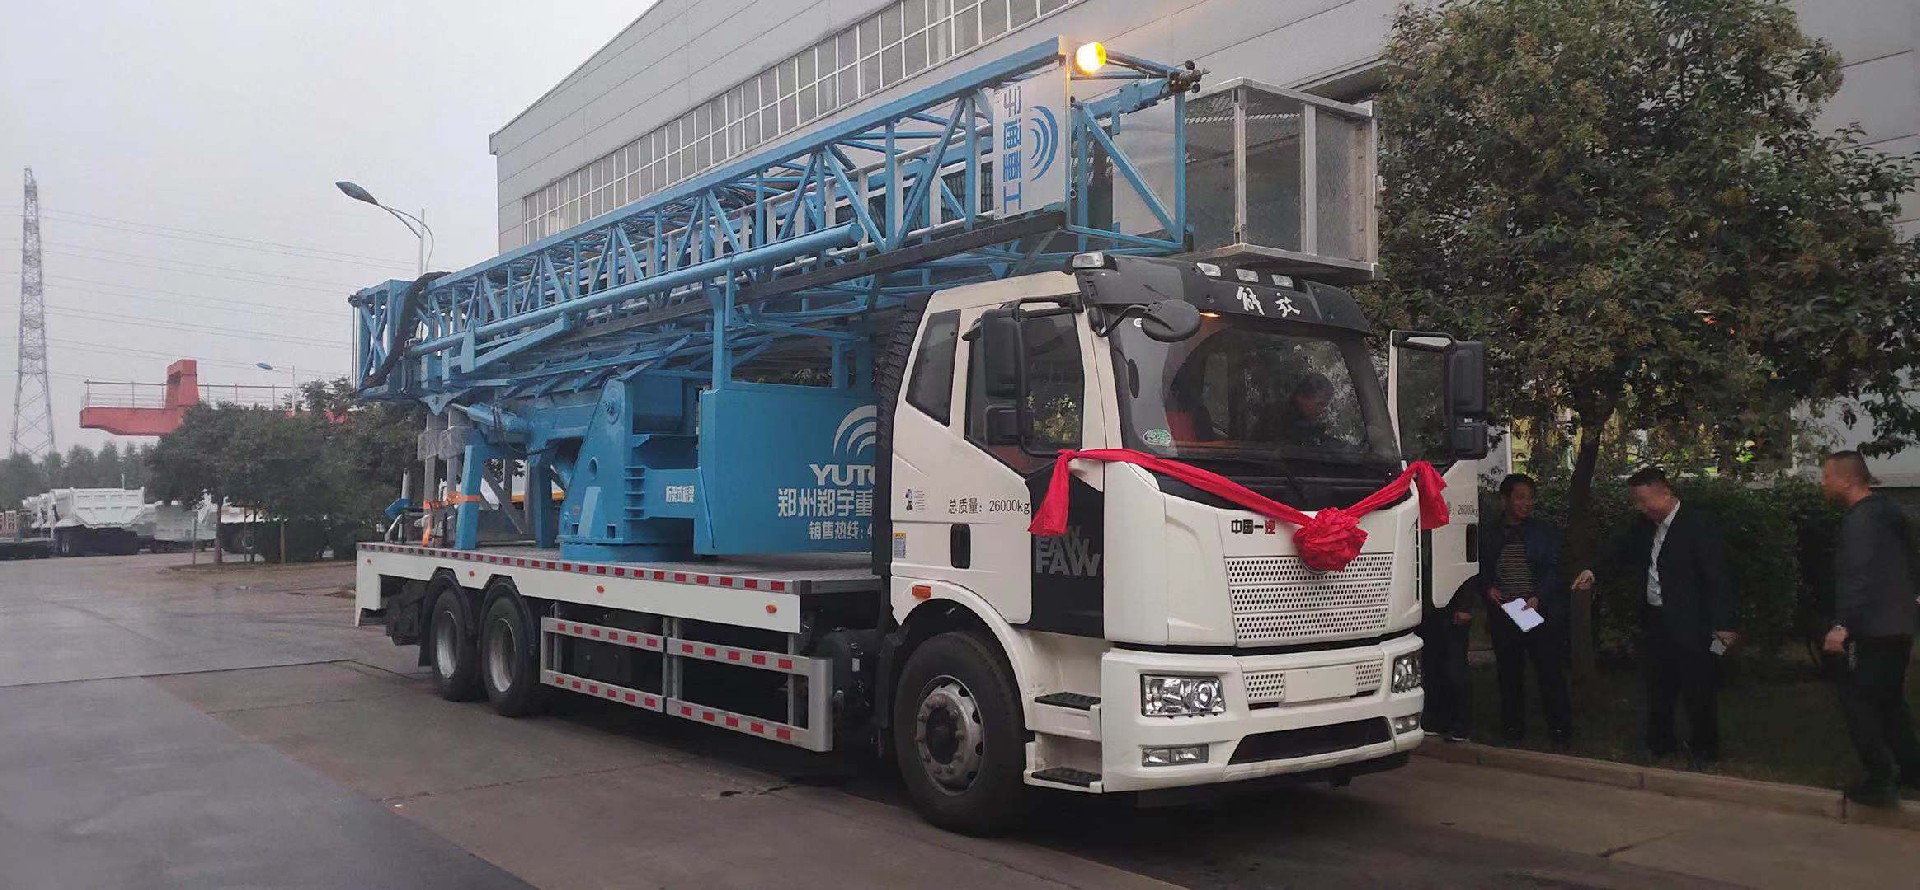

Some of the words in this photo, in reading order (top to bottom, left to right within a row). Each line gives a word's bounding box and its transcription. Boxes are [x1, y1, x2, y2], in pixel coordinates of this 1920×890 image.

[778, 488, 872, 517] 郑州郑宇重
[1036, 552, 1101, 577] FAW
